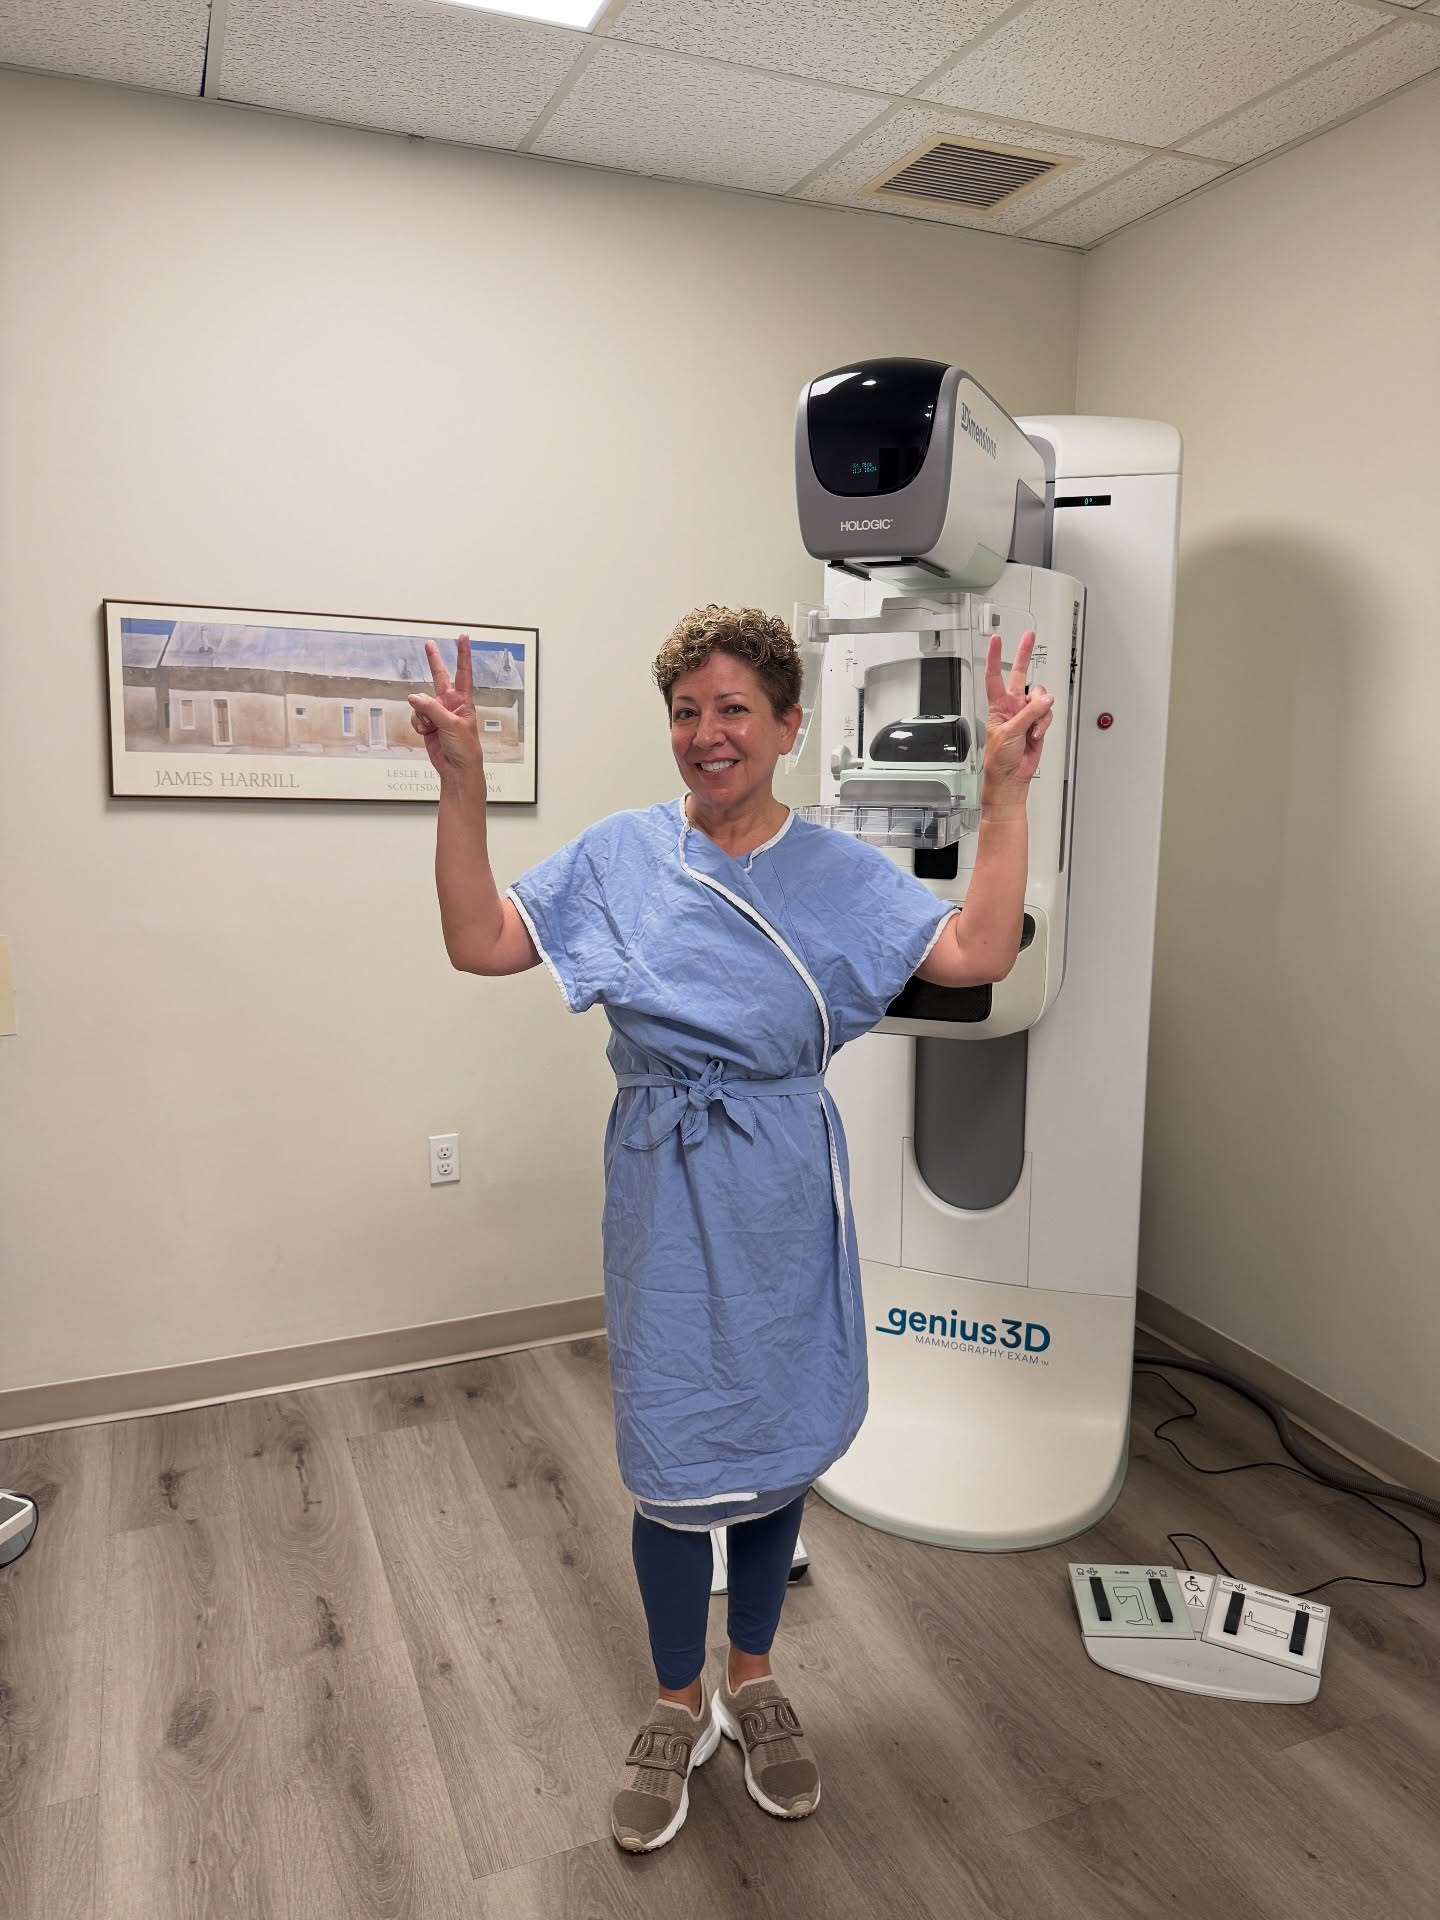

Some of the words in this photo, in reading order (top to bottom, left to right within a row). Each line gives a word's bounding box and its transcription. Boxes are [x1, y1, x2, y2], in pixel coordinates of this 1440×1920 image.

[840, 519, 891, 531] HOLOGIC
[154, 770, 213, 787] JAMES
[220, 772, 299, 788] HARRILL
[387, 783, 440, 792] SCOTTSDA
[915, 1335, 1004, 1358] MAMMOGRAPHY
